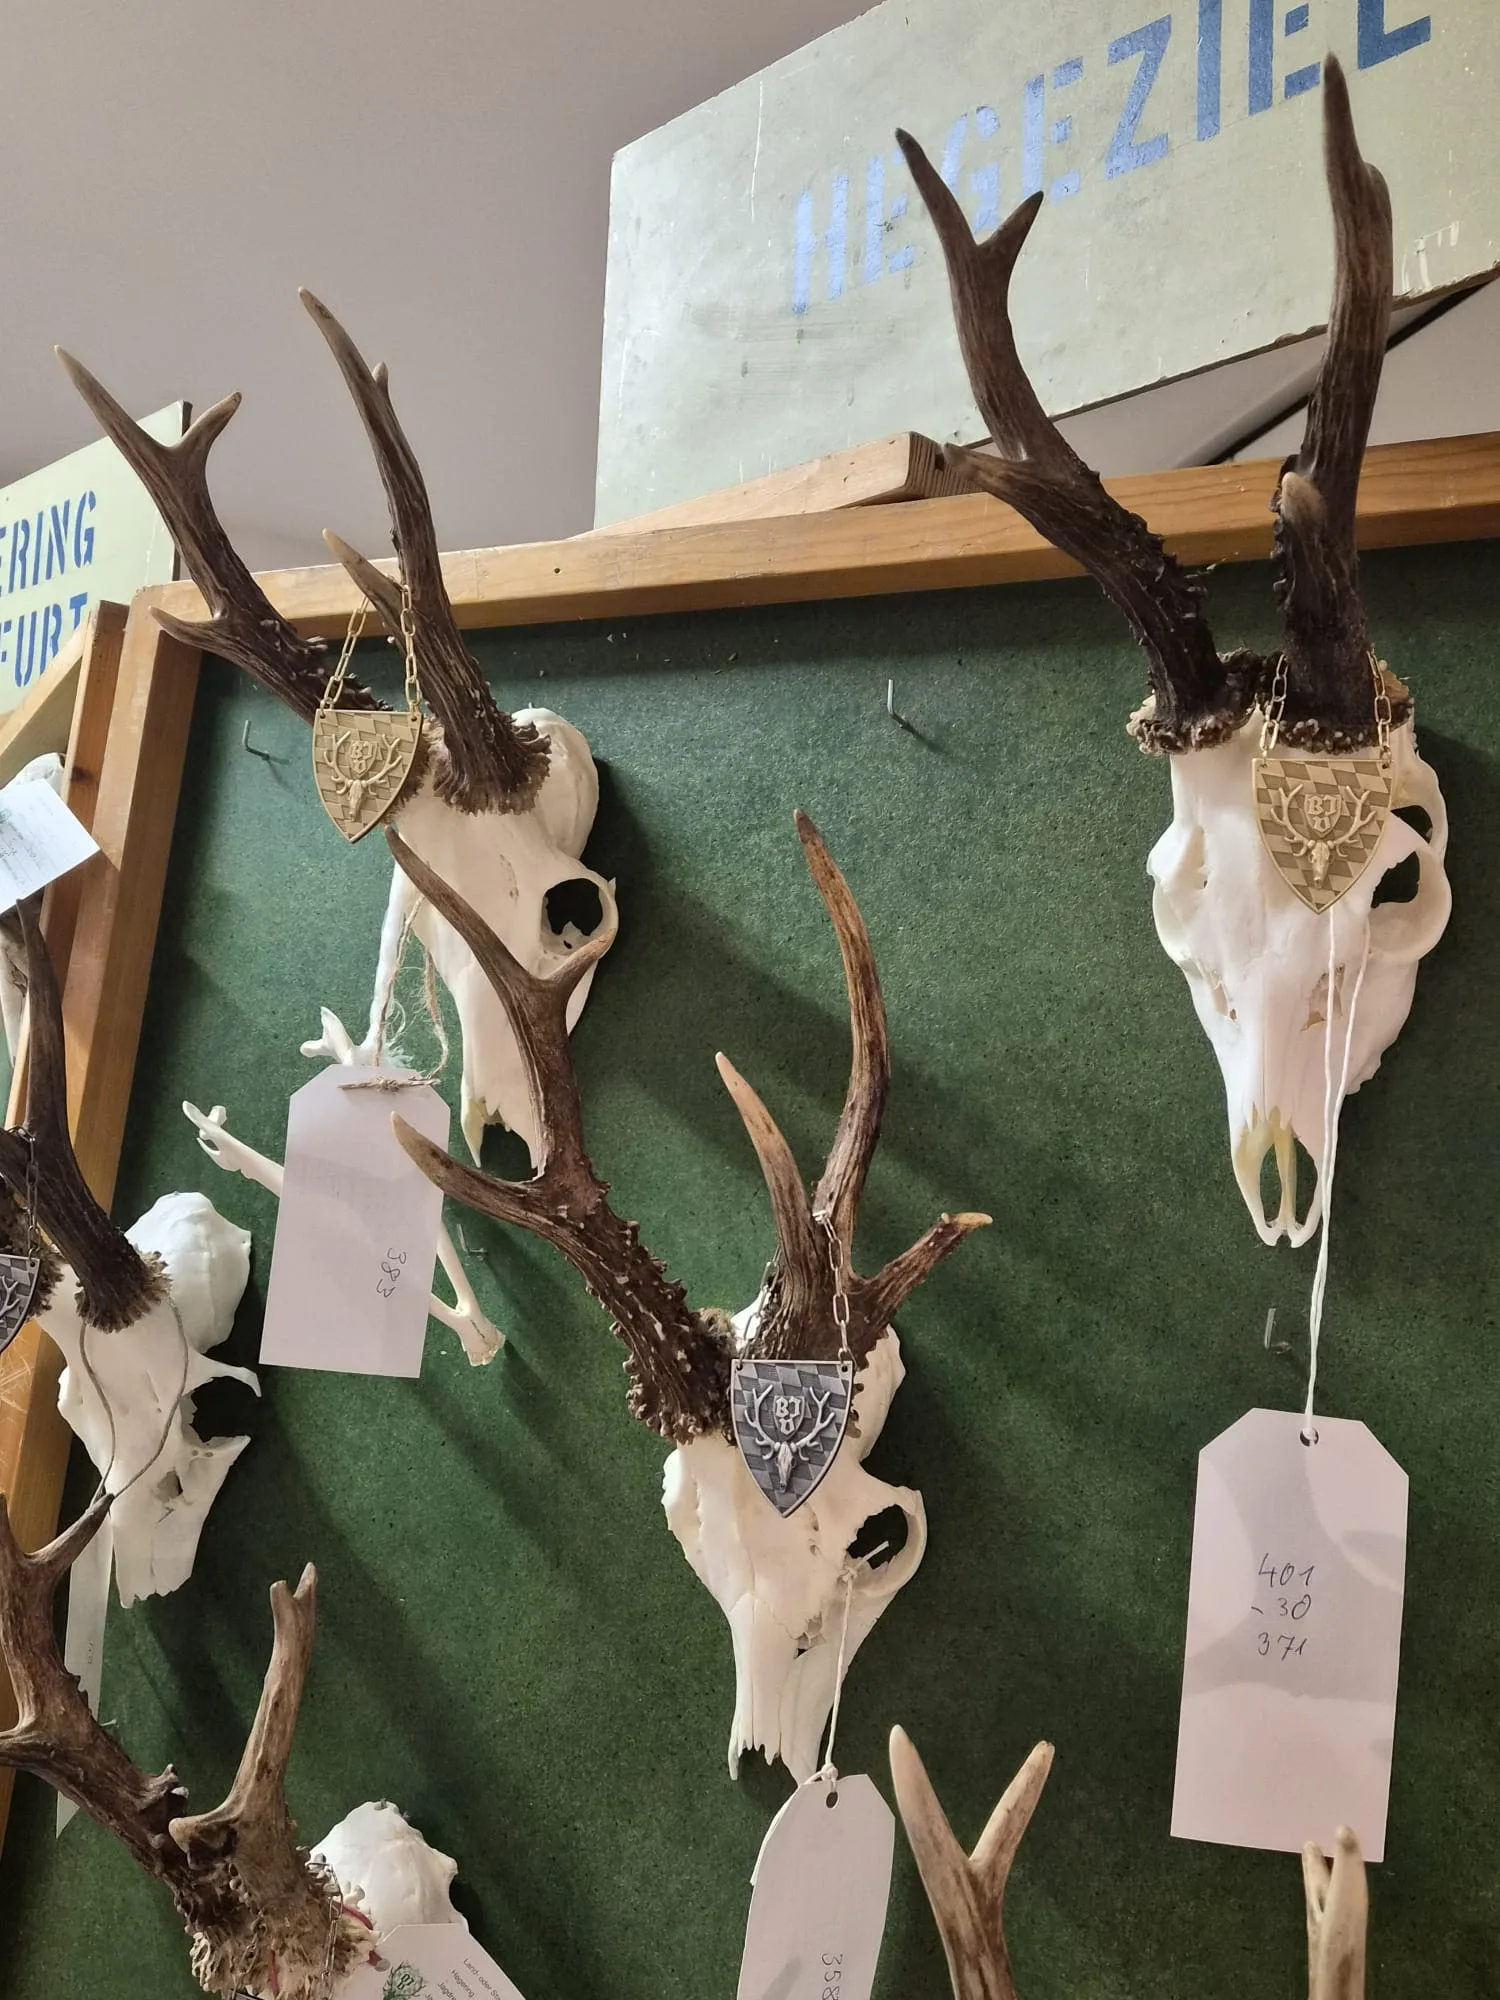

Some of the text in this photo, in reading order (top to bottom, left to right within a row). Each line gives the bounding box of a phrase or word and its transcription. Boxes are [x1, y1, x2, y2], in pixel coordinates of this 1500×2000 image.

[375, 1247, 407, 1299] 383
[1258, 1552, 1315, 1588] 401
[1257, 1632, 1308, 1661] 371
[821, 1953, 843, 2000] 358
